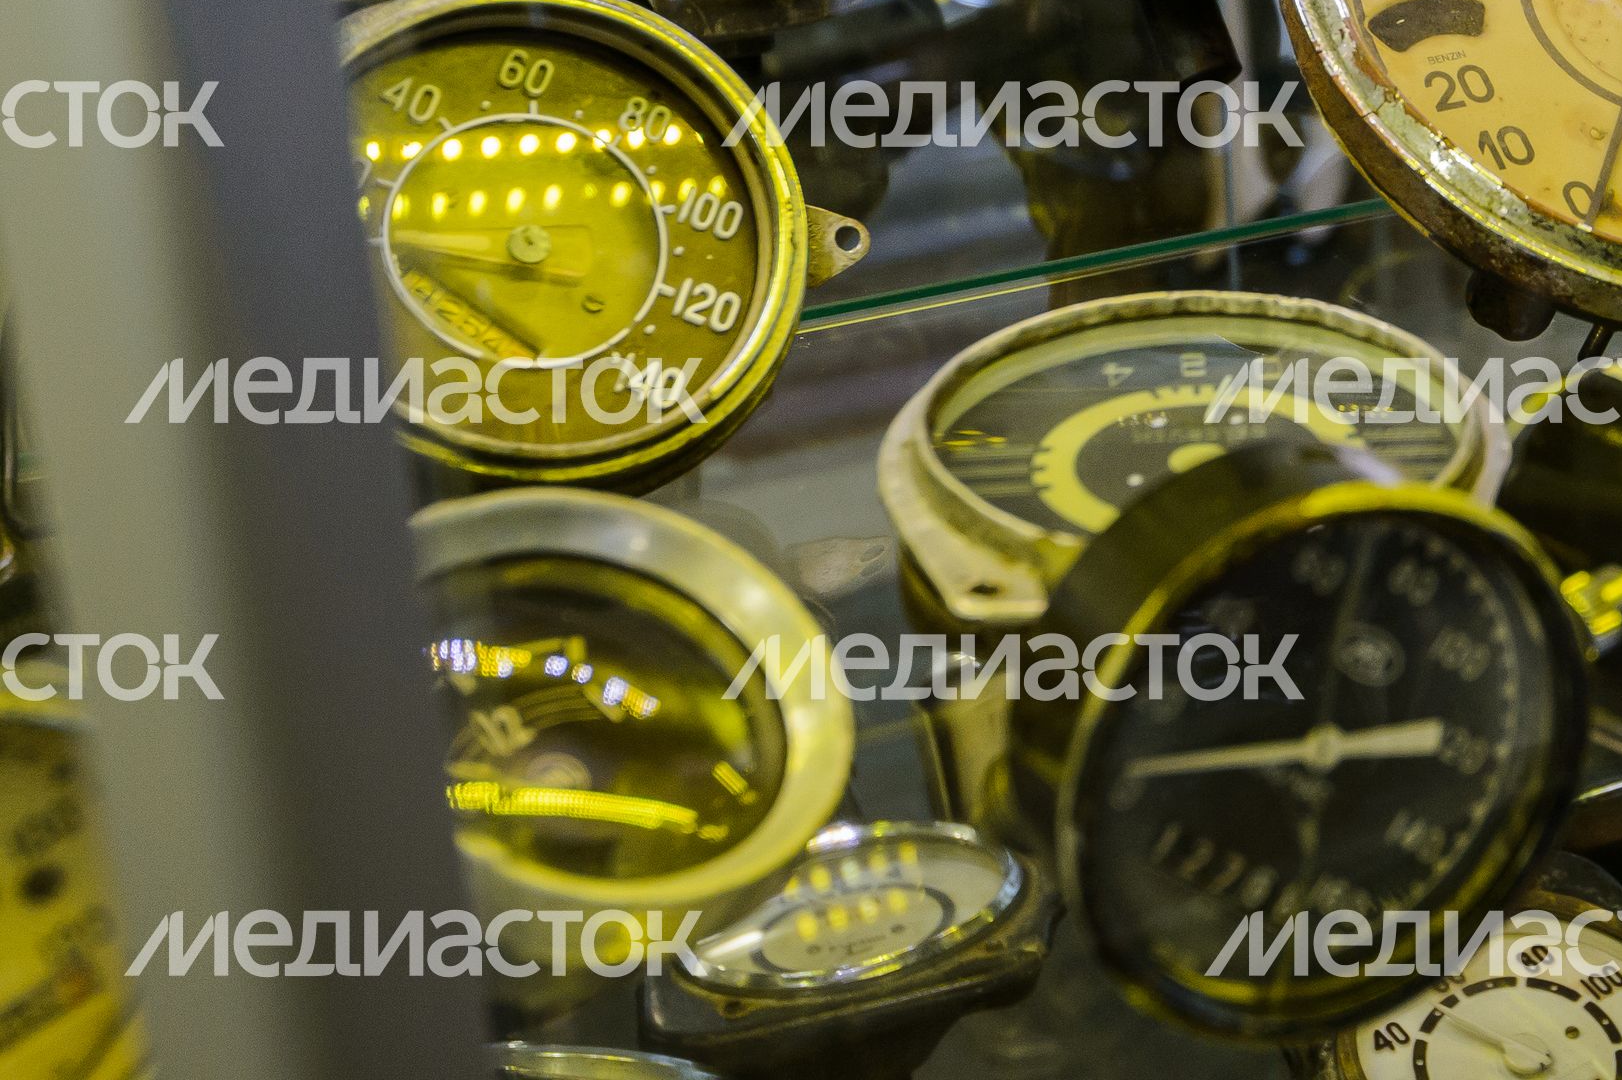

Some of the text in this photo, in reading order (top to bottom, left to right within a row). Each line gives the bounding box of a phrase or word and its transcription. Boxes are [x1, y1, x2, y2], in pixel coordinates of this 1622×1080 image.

[499, 48, 556, 97] 60
[1427, 49, 1468, 66] BENZIN
[381, 76, 443, 125] 40
[1423, 64, 1495, 113] 20
[617, 95, 673, 143] 80
[1477, 125, 1536, 170] 10
[677, 185, 745, 242] 100
[1562, 179, 1597, 221] 0
[672, 276, 743, 334] 120
[1372, 1021, 1412, 1054] 40
